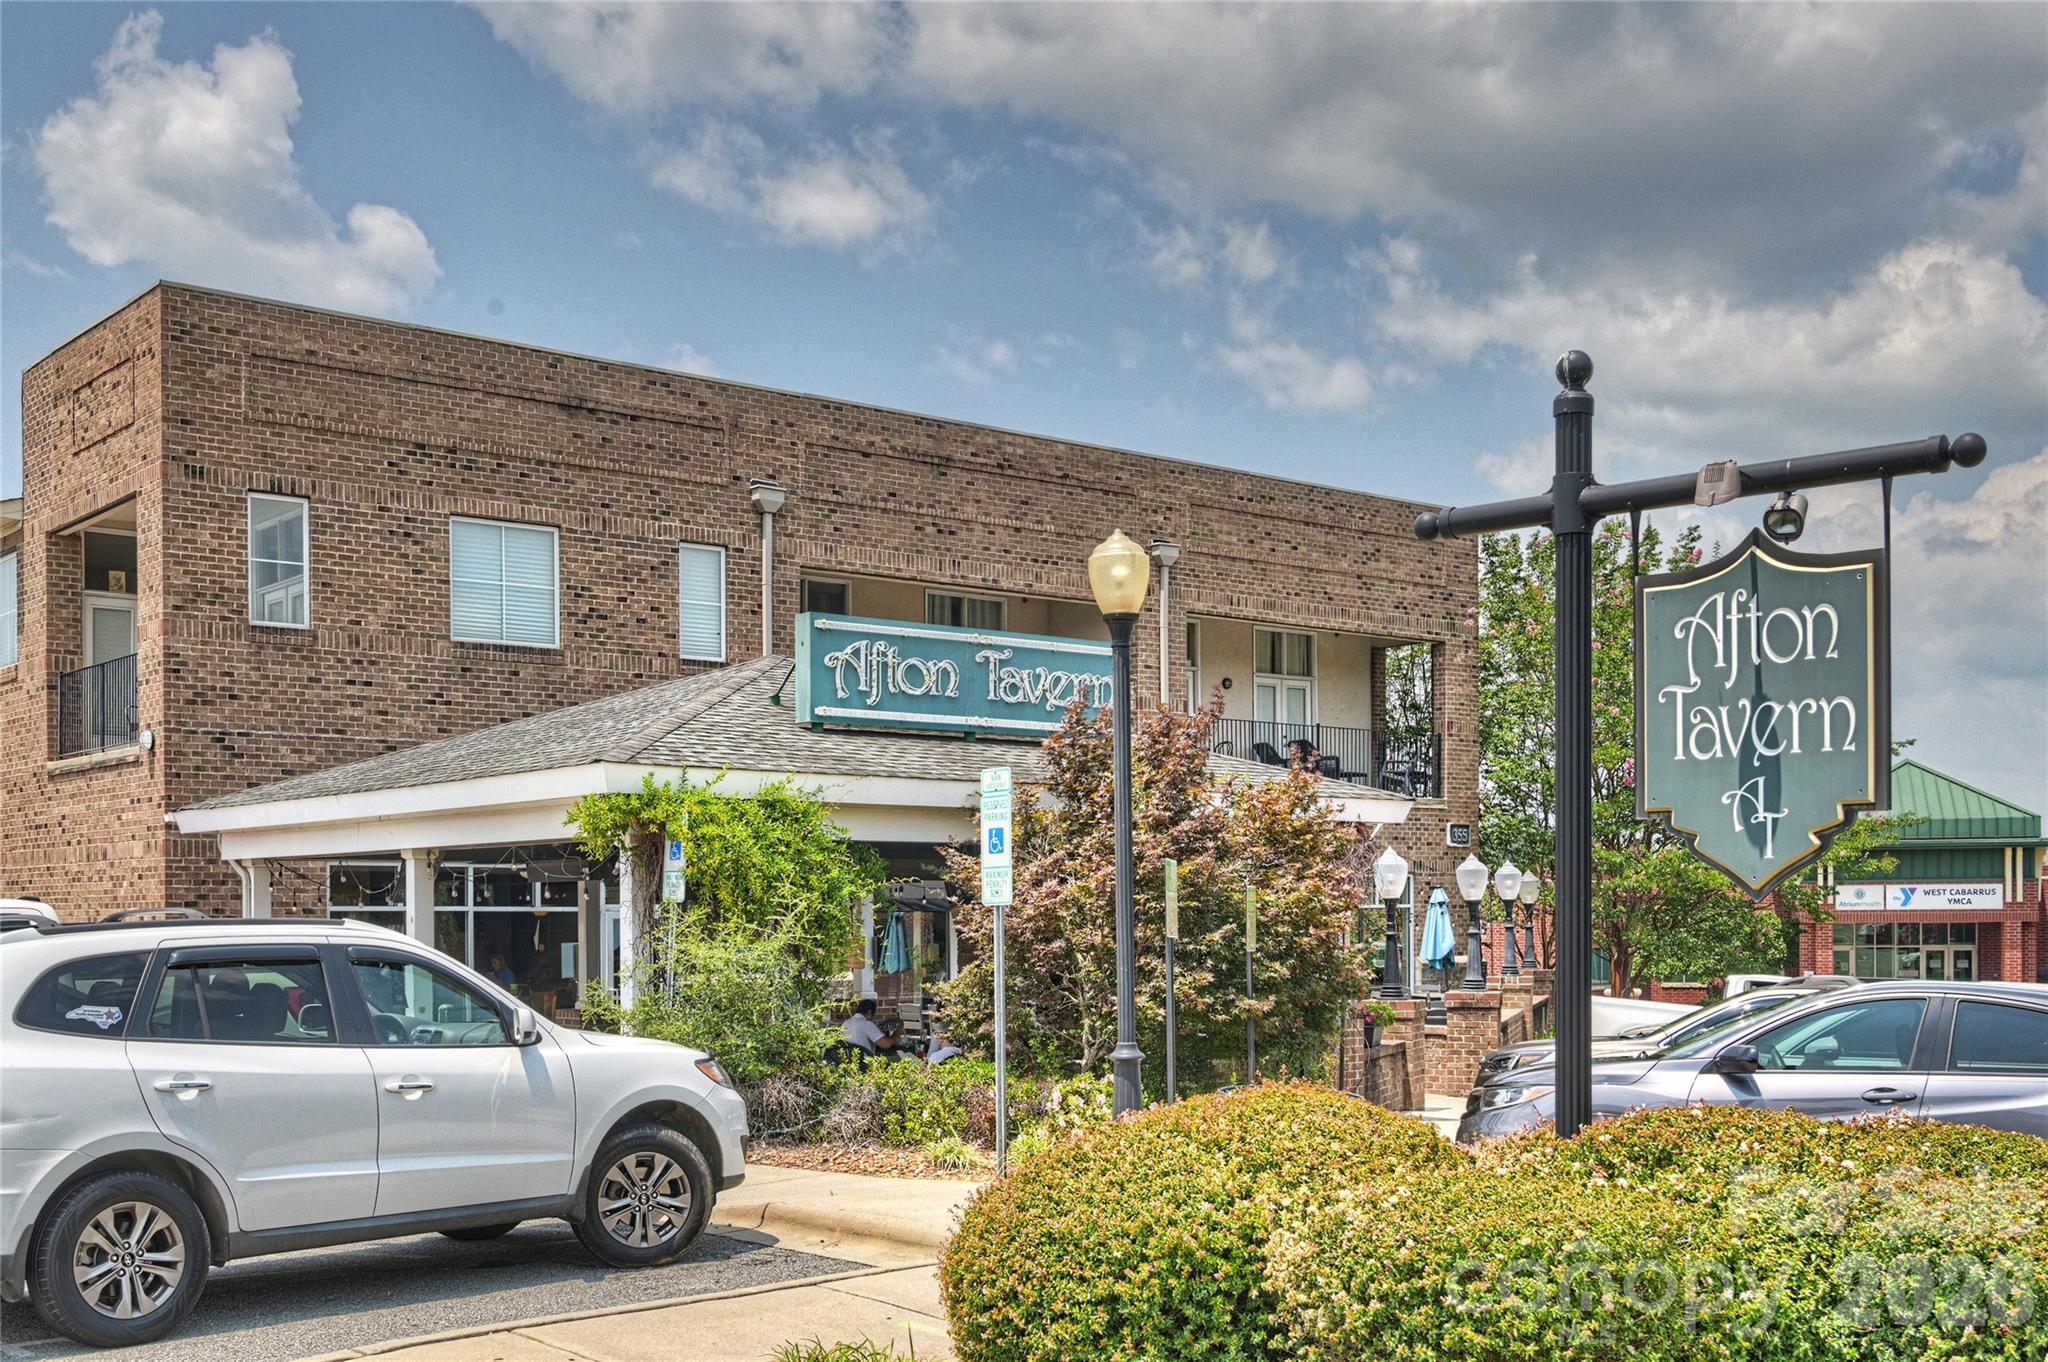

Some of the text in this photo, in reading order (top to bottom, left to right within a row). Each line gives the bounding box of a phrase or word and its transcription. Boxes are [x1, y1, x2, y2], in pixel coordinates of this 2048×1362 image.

[1674, 588, 1838, 690] Afton
[824, 639, 1113, 711] Afton Tavern
[1658, 678, 1857, 767] Tavern
[984, 811, 1008, 821] PARKING
[1452, 828, 1468, 842] 355
[985, 880, 1008, 889] PENALTY
[1923, 888, 1997, 897] WEST CABARRUS
[1947, 897, 1973, 905] YMCA
